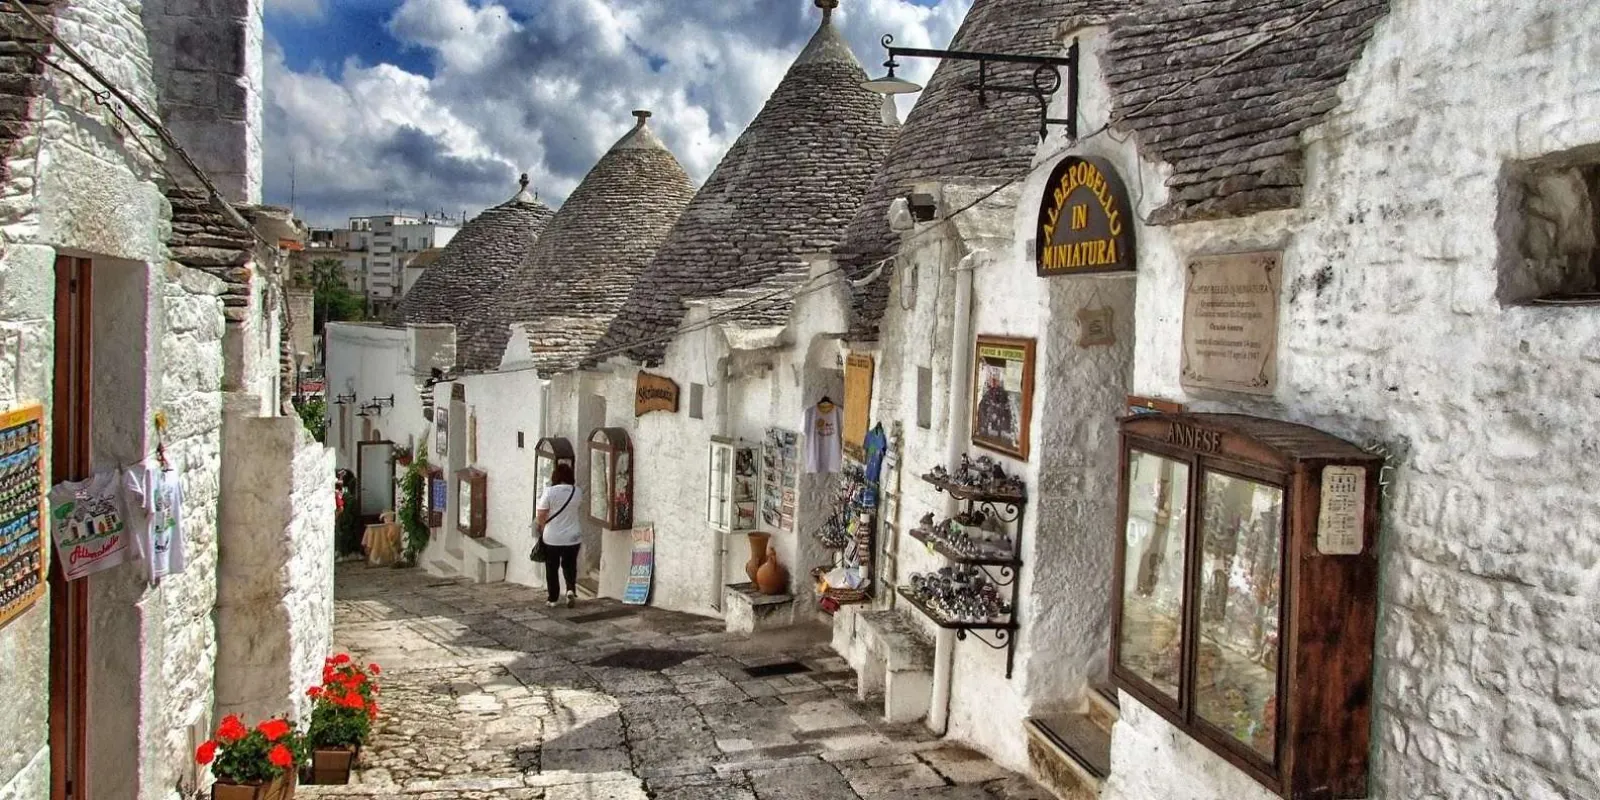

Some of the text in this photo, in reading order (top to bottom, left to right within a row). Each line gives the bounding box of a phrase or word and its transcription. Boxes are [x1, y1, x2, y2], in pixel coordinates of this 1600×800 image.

[1072, 204, 1087, 229] IN
[1042, 238, 1117, 269] MINIATURA
[1168, 421, 1222, 453] ANNESE
